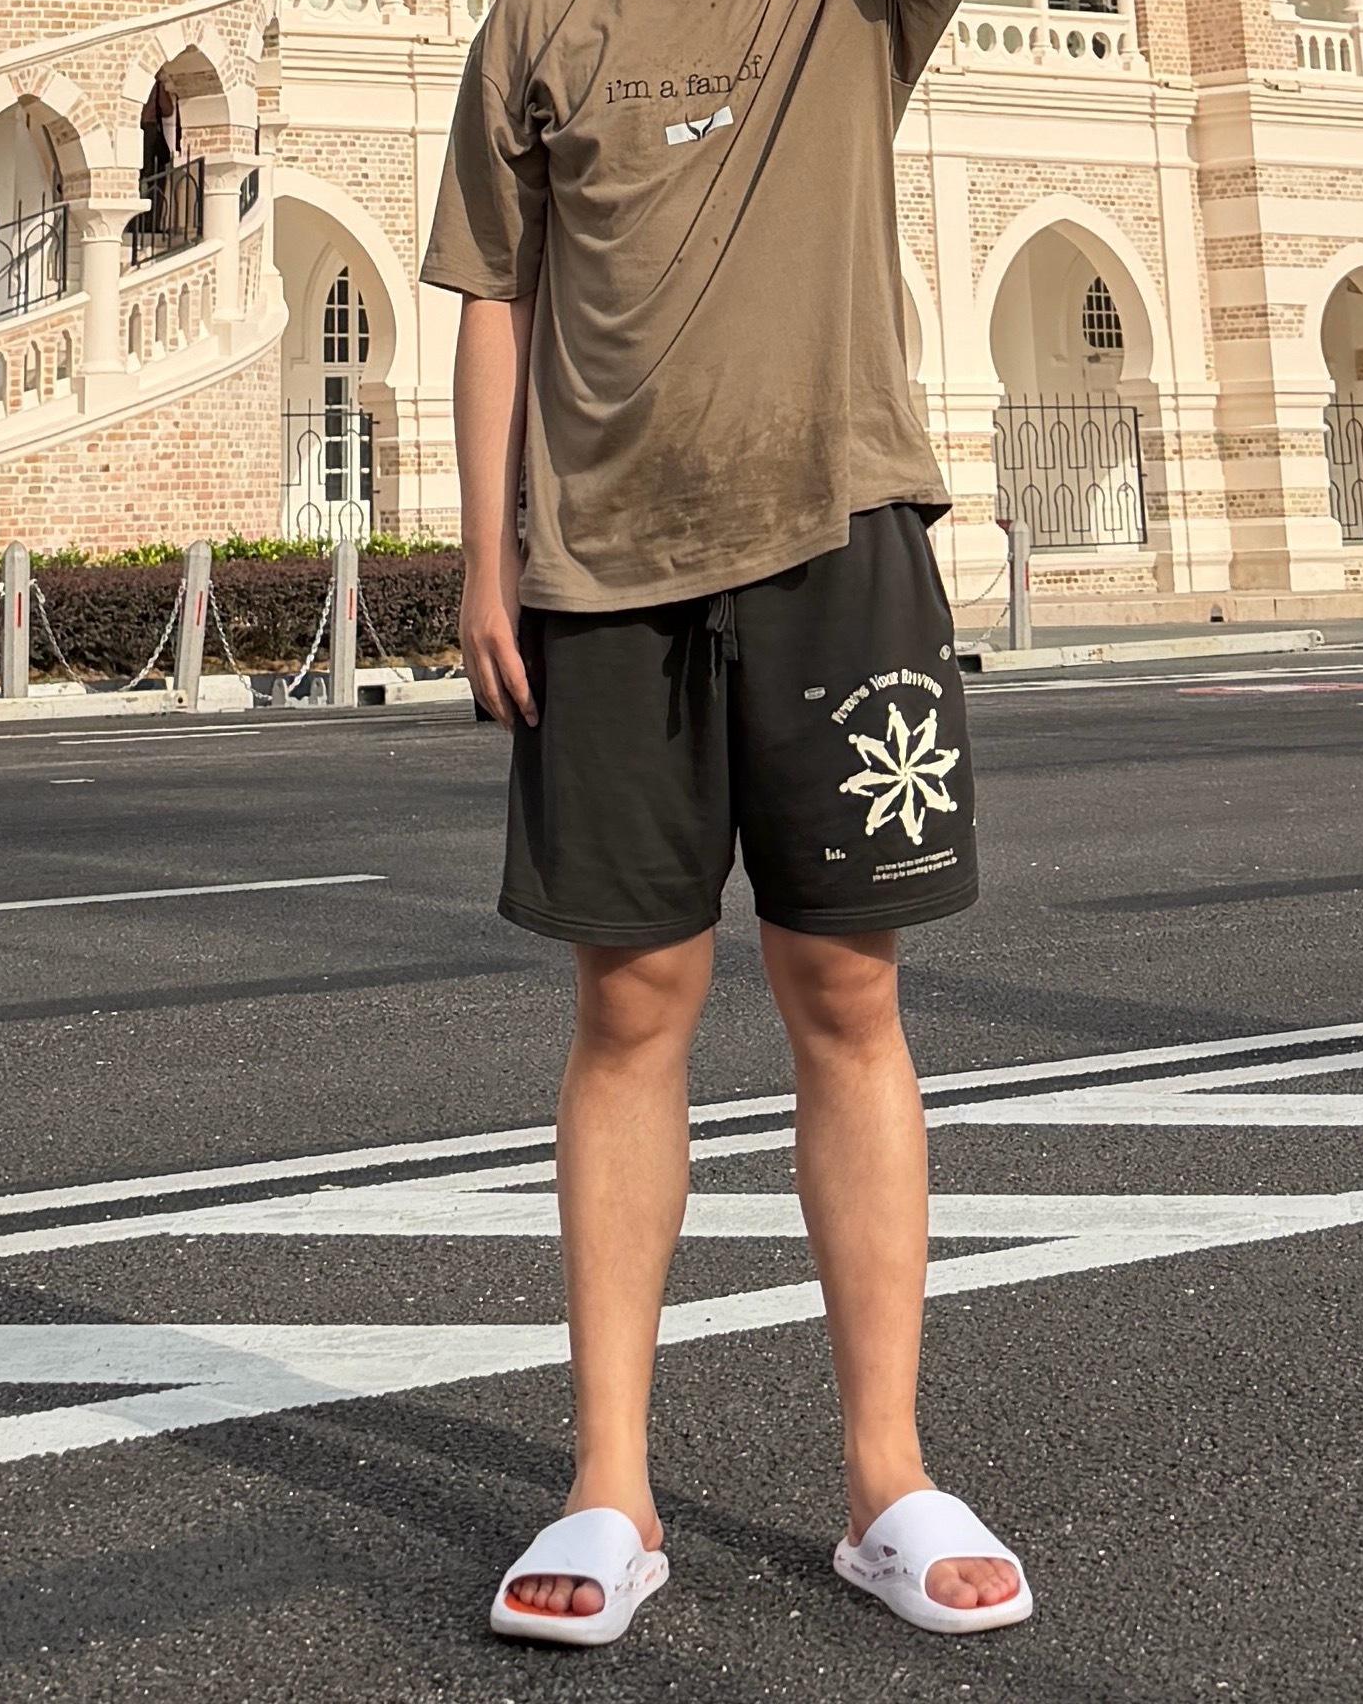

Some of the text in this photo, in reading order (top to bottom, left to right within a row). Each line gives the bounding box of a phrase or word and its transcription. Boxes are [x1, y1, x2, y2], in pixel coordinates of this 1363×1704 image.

[605, 54, 763, 104] i'm a fan of
